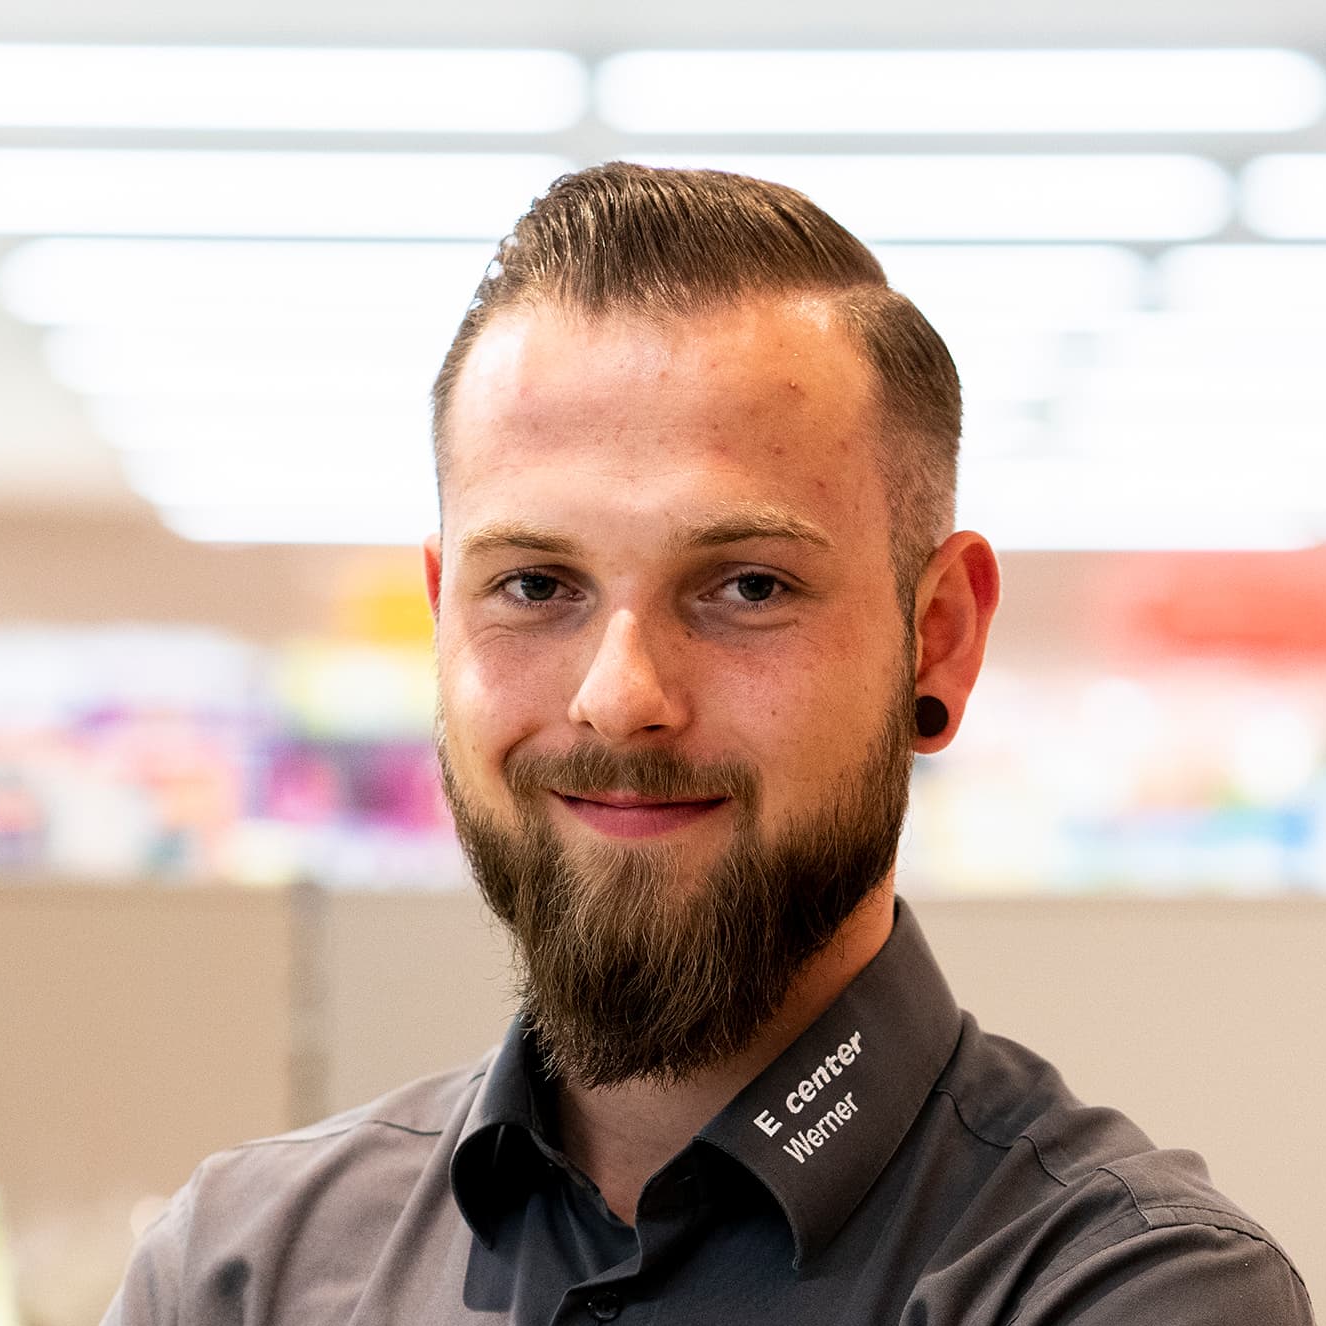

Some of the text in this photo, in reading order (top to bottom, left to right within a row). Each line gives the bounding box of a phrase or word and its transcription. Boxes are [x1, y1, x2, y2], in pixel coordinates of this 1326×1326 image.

[753, 1031, 862, 1138] E center
[782, 1091, 859, 1164] Werner
